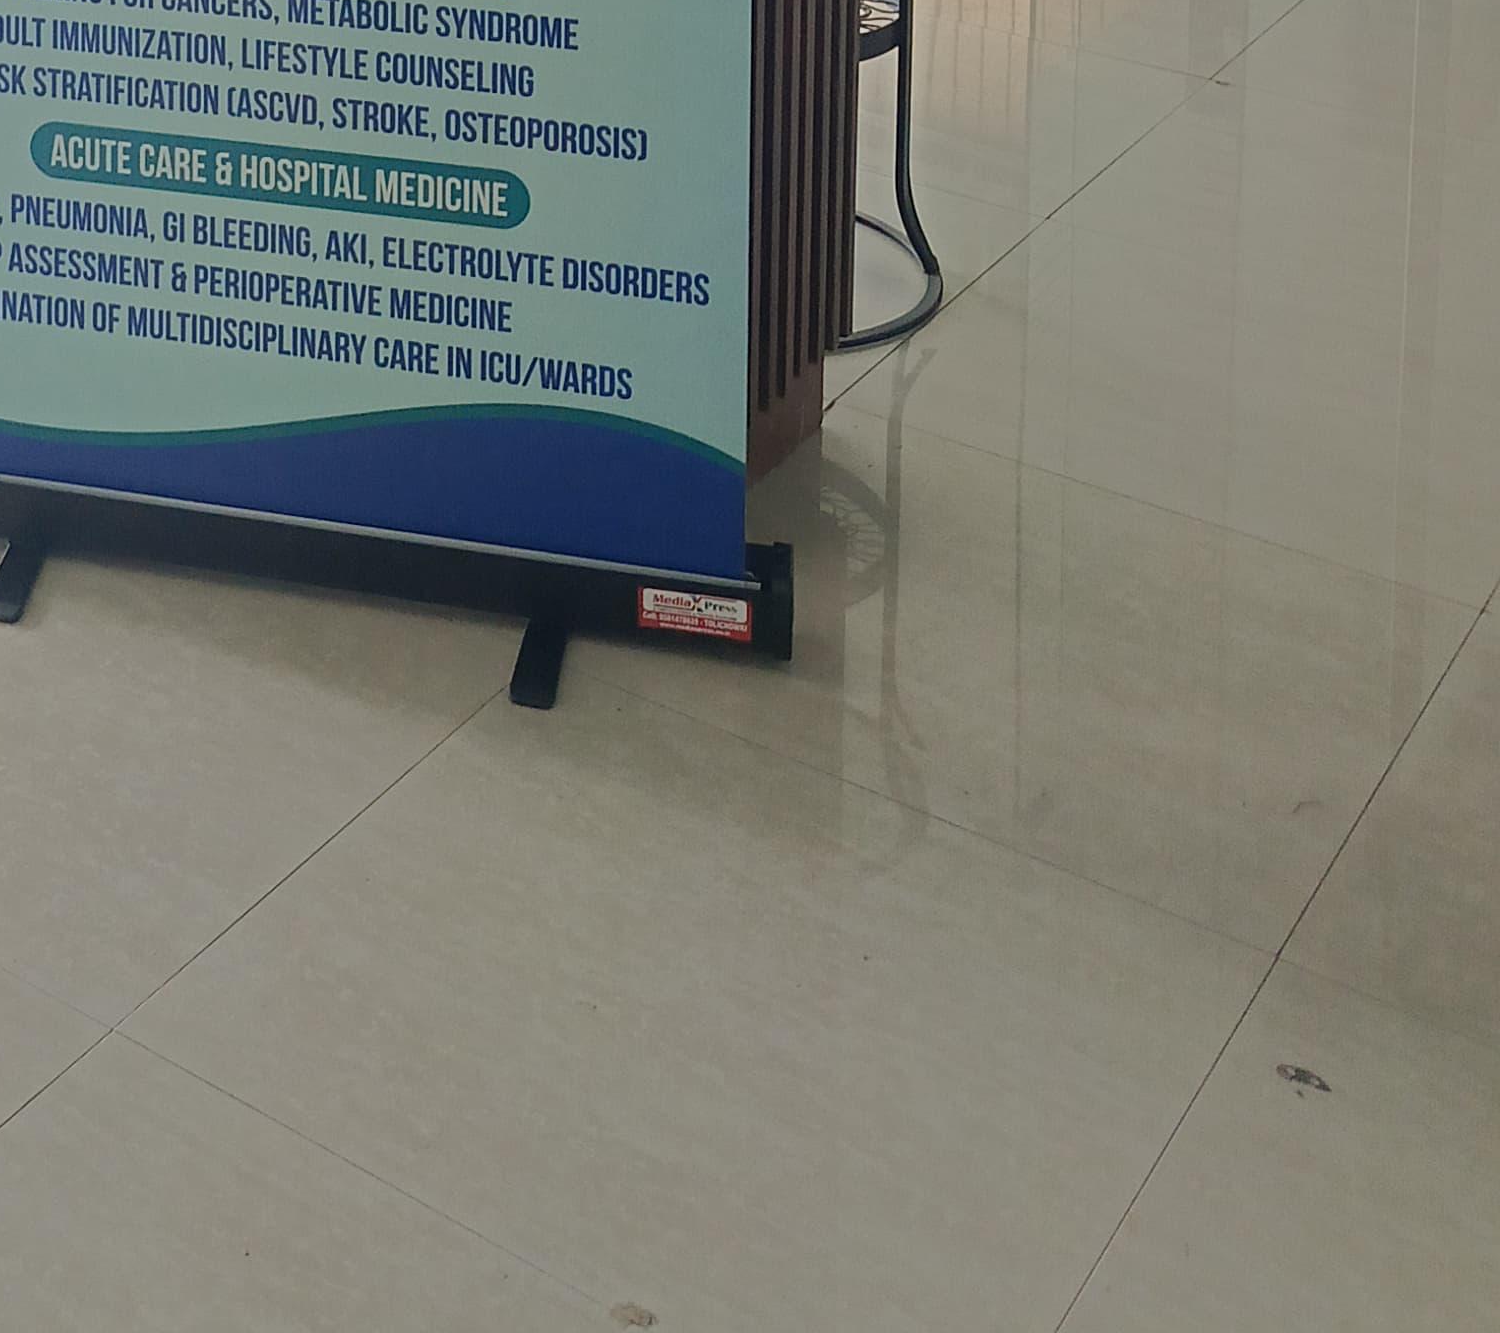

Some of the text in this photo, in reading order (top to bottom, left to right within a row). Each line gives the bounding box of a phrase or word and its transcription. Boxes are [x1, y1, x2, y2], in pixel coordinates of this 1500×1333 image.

[52, 18, 234, 72] IMMUNIZATION,
[241, 37, 369, 81] LIFESTYLE
[375, 50, 535, 98] COUNSELING
[435, 5, 580, 51] SYNDROME
[32, 66, 219, 116] STRATIFICATION
[227, 86, 325, 131] (ASCVD,
[332, 97, 437, 143] STROKE,
[444, 108, 648, 162] OSTEOPOROSIS)
[50, 133, 509, 217] ACUTE CARE & HOSPITAL MEDICINE
[7, 241, 165, 290] ASSESSMENT
[171, 261, 188, 293] &
[193, 259, 383, 317] PERIOPERATIVE
[389, 287, 513, 334] MEDICINE
[10, 193, 156, 244] PNEUMONIA,
[162, 210, 186, 244] GI
[192, 214, 318, 263] BLEEDING,
[324, 229, 375, 270] AKI,
[382, 235, 555, 288] ELECTROLYTE
[562, 257, 710, 307] DISORDERS
[92, 301, 122, 334] OF
[127, 305, 367, 366] MULTIDISCIPLINARY
[373, 336, 440, 376] CARE
[446, 345, 473, 380] IN
[480, 349, 633, 400] ICU/WARDS
